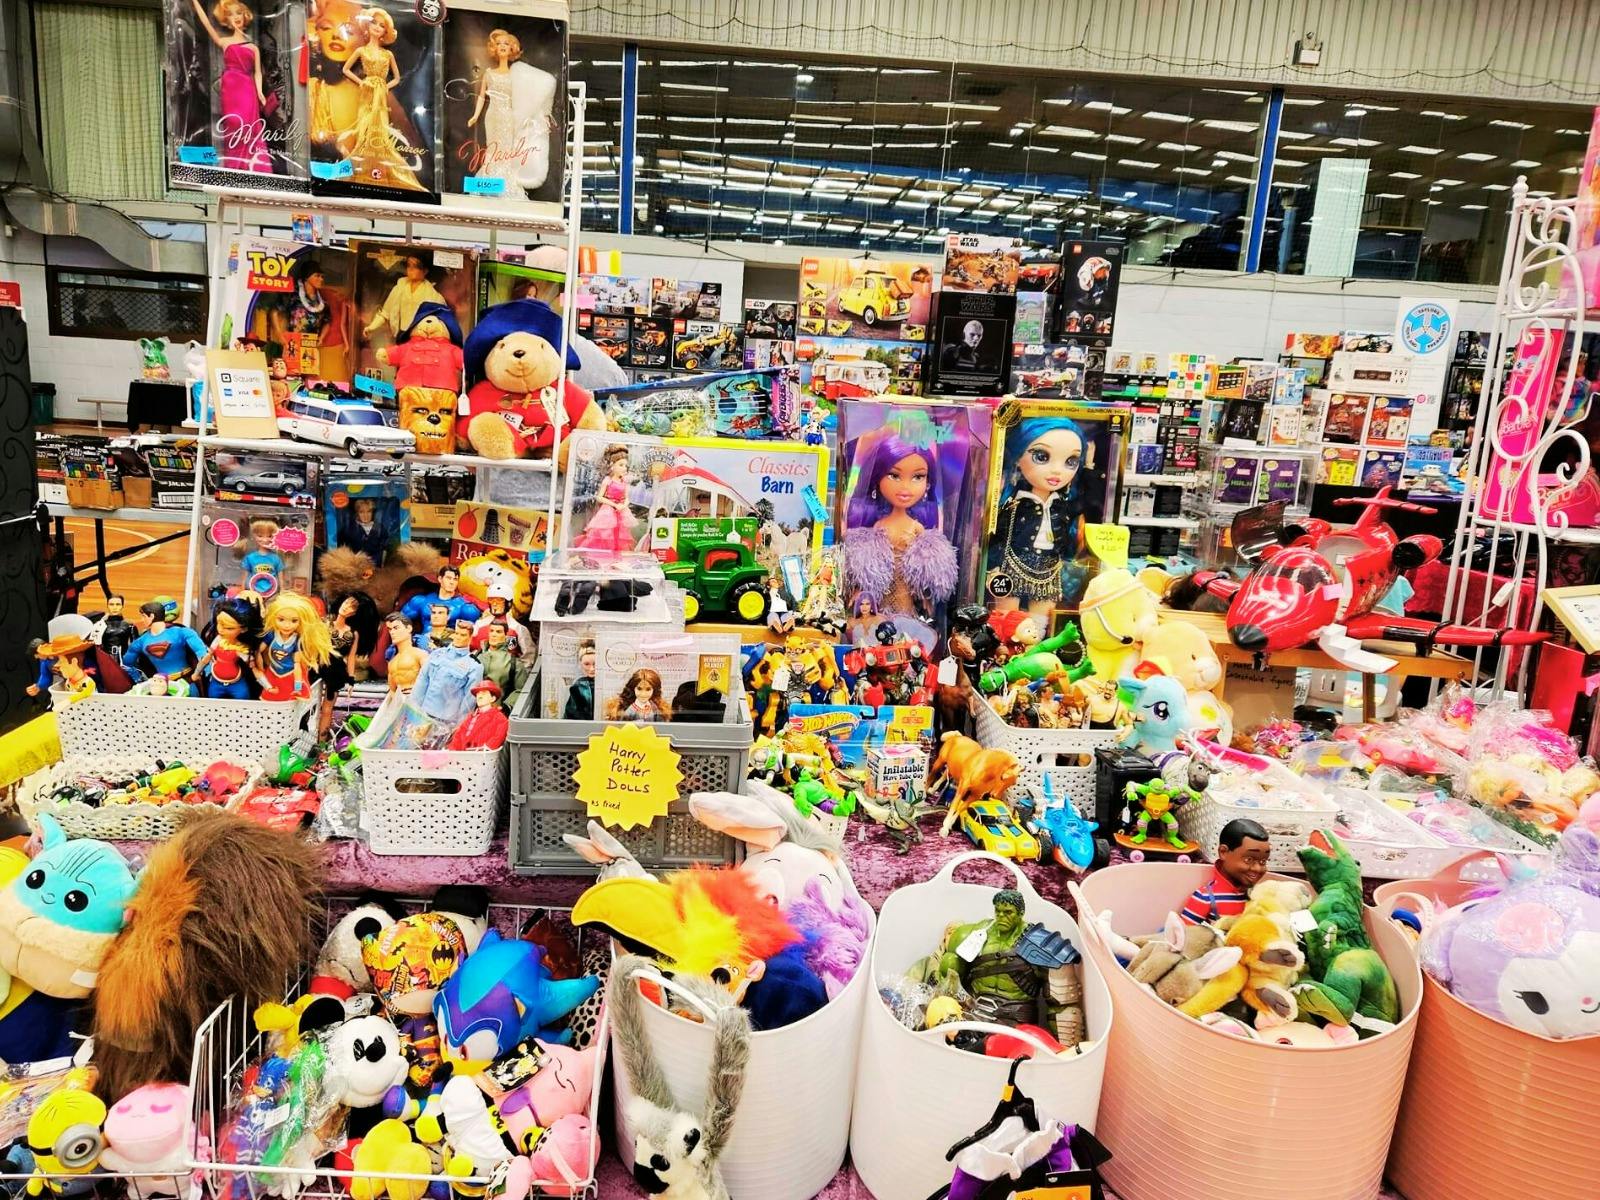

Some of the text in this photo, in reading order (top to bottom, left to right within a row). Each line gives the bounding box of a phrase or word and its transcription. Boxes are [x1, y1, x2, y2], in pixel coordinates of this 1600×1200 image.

[213, 113, 304, 154] Marily
[458, 137, 541, 174] Marilyn
[247, 251, 297, 278] TOY
[252, 276, 290, 288] STORY
[233, 375, 261, 383] Square
[748, 456, 810, 476] Classics
[761, 476, 794, 494] Barn
[805, 717, 823, 730] HOT
[609, 741, 646, 764] Harry
[611, 758, 651, 777] Potter
[883, 764, 925, 775] Inflatable
[606, 778, 650, 793] DOLLS
